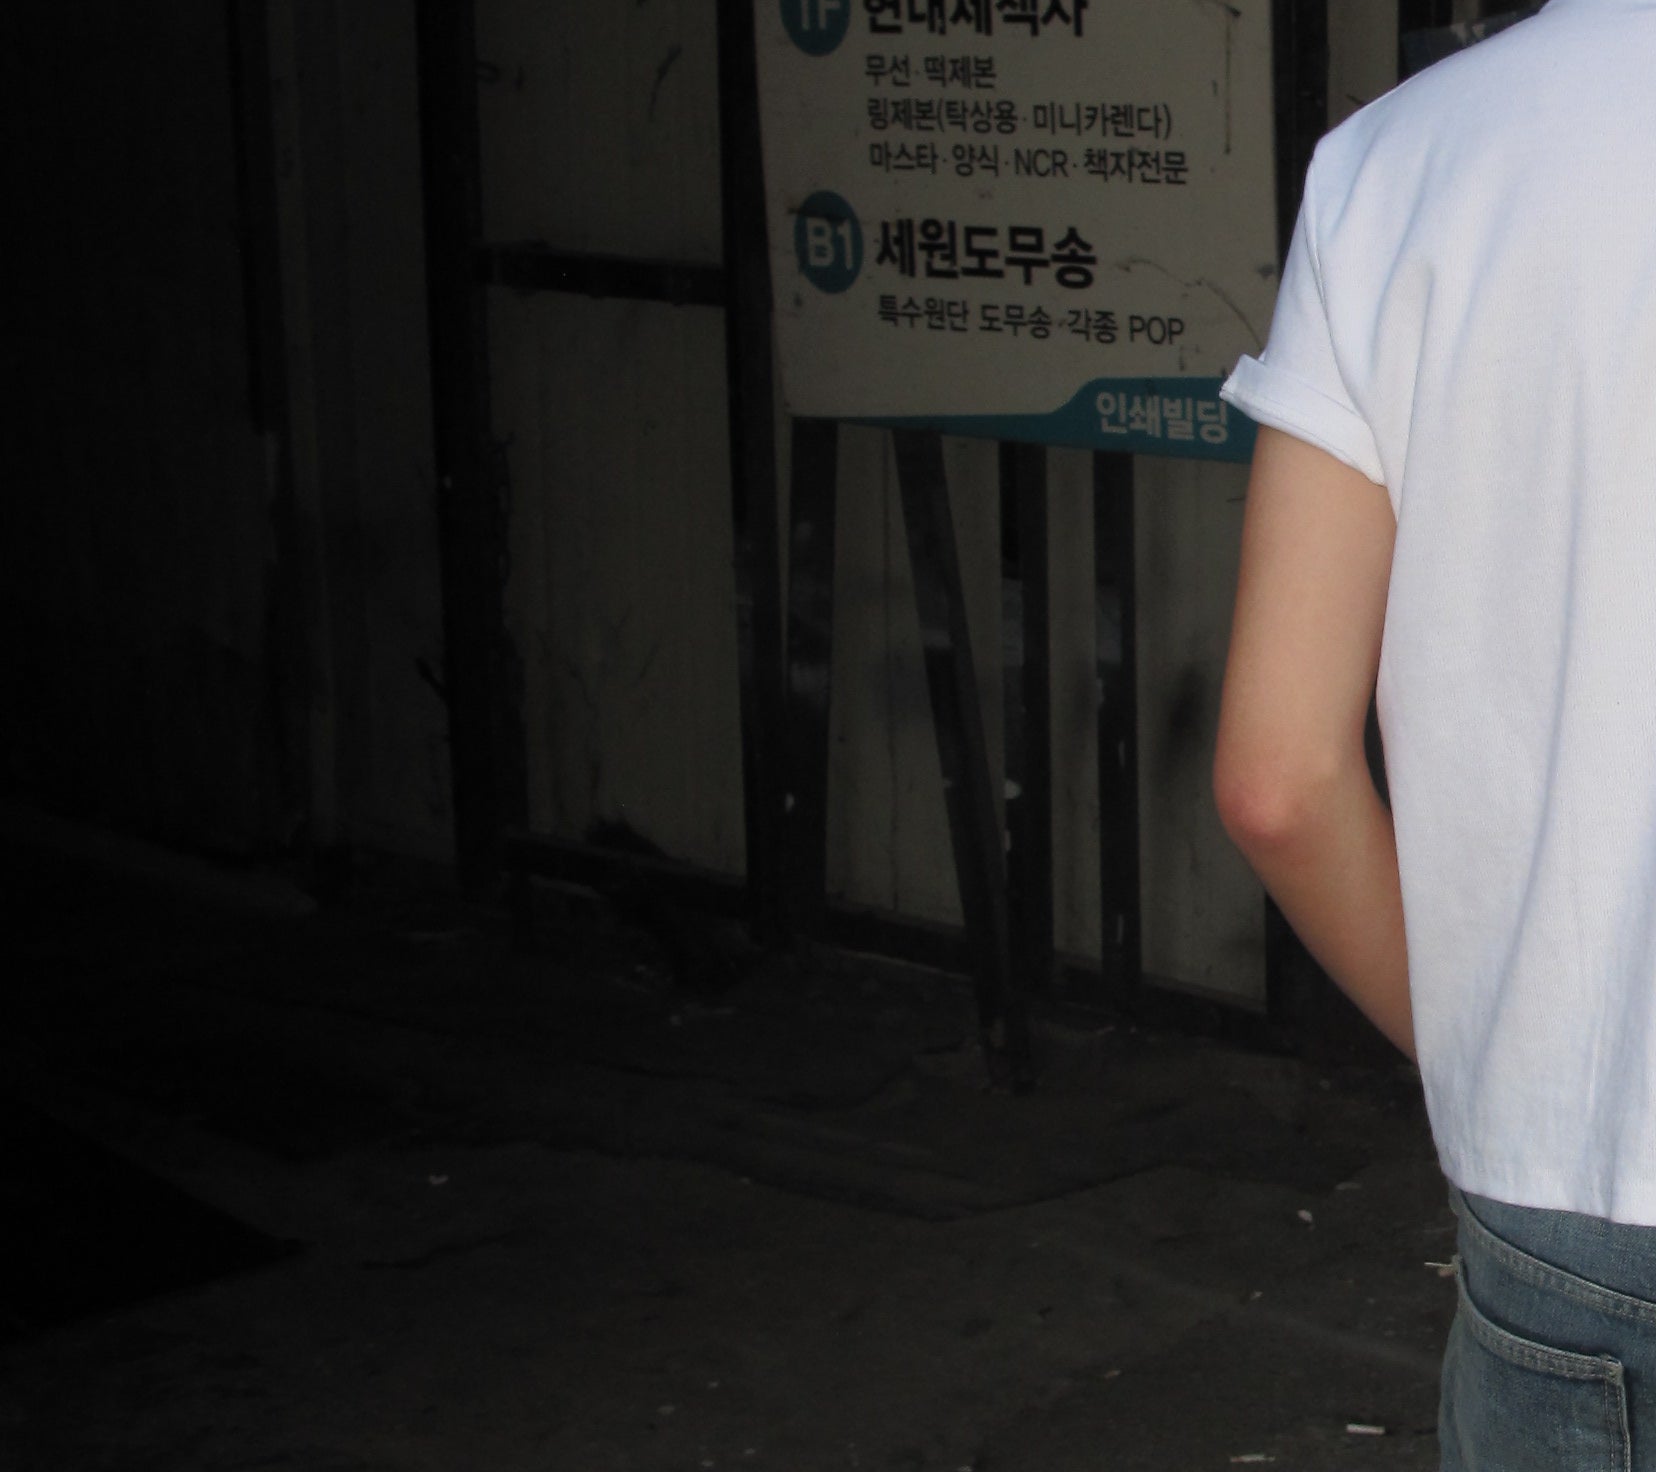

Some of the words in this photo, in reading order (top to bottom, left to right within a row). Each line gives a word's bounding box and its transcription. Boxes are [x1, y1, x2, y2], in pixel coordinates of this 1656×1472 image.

[805, 216, 855, 272] B1
[876, 218, 1098, 289] 세원도무송
[876, 293, 969, 332] 특수원단
[1128, 314, 1187, 345] POP
[1095, 390, 1230, 446] 인쇄빌딩
